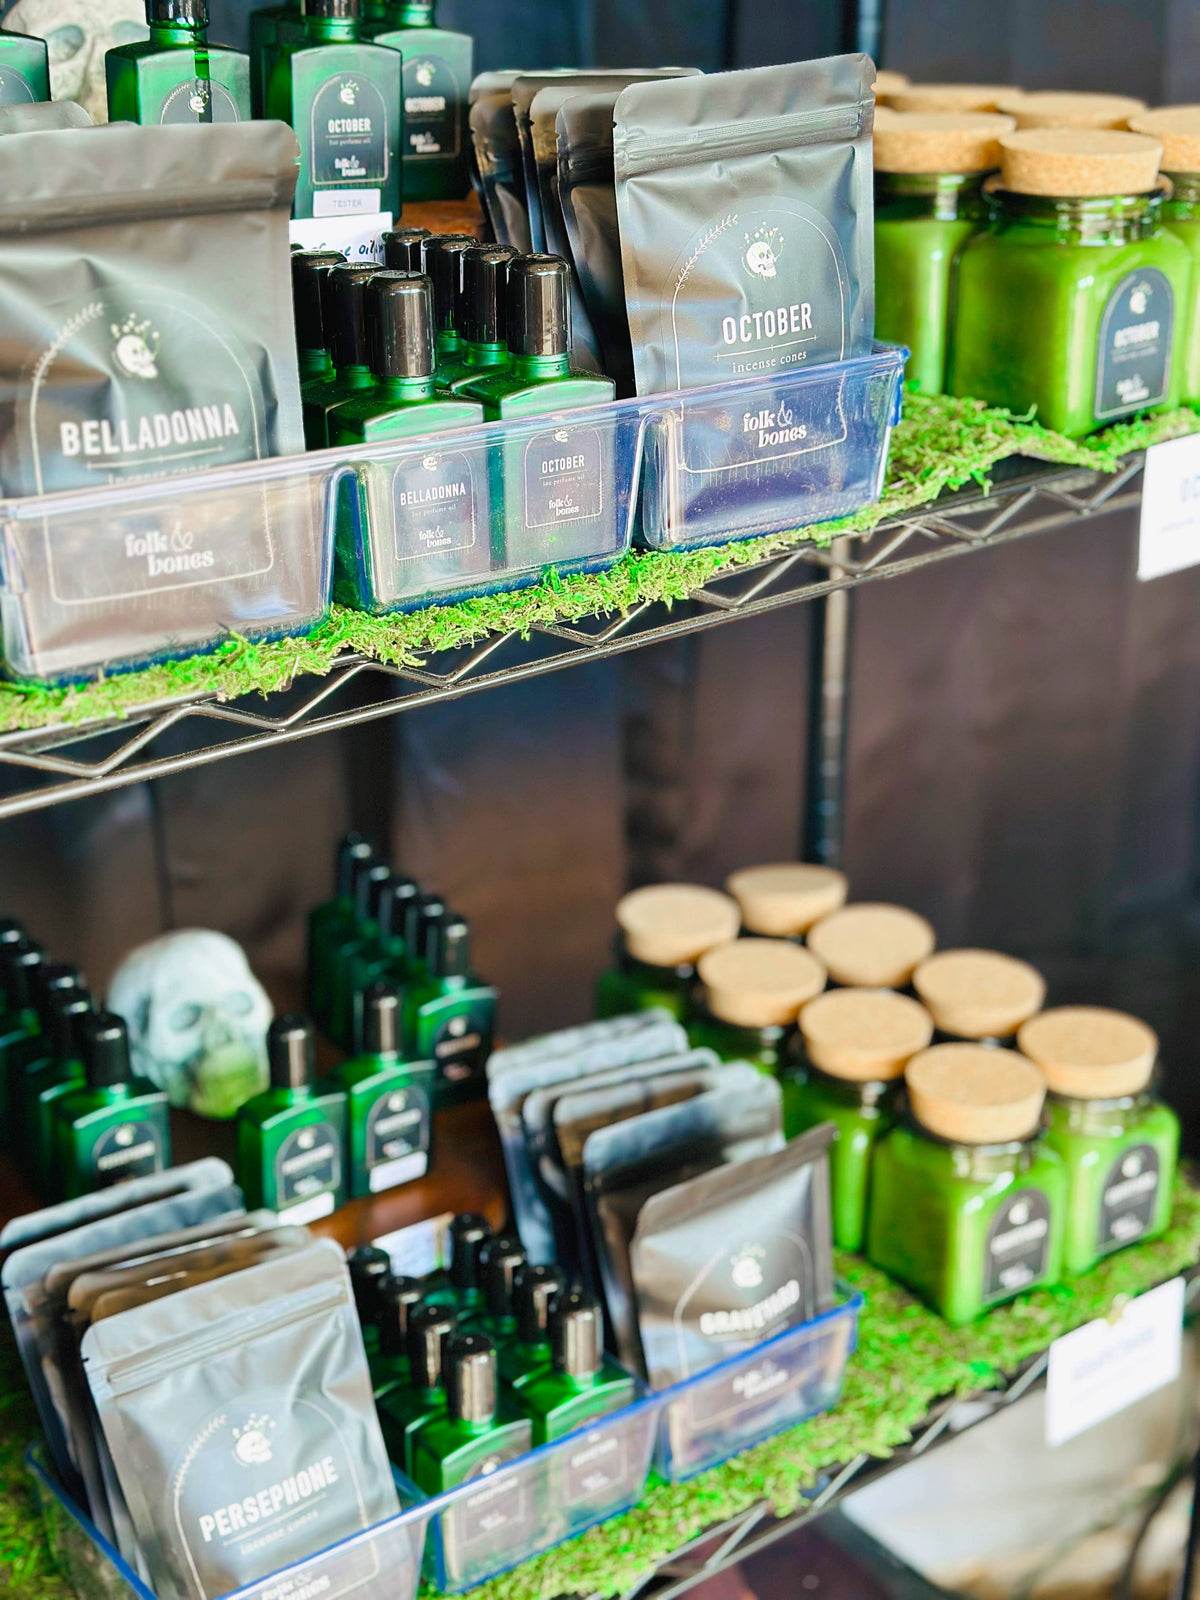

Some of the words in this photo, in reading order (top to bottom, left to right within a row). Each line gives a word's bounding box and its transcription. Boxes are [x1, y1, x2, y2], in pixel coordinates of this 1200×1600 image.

[327, 118, 371, 133] OCTOBER
[332, 199, 363, 208] TESTER
[722, 302, 813, 345] OCTOBER
[732, 359, 777, 374] incense
[780, 351, 807, 364] cones
[743, 410, 776, 432] folk
[777, 399, 793, 428] &
[60, 402, 240, 457] BELLADONNA
[758, 424, 807, 448] bones
[541, 454, 586, 474] OCTOBER
[553, 475, 577, 487] perfume
[577, 472, 585, 480] oil
[399, 481, 467, 506] BELLADONNA
[548, 498, 564, 510] folk
[423, 507, 448, 517] perfume
[555, 505, 581, 517] bones
[124, 530, 170, 558] folk
[170, 519, 194, 553] &
[418, 530, 435, 541] folk
[426, 537, 453, 549] bones
[147, 549, 215, 577] bones
[199, 1455, 339, 1543] PERSEPHONE
